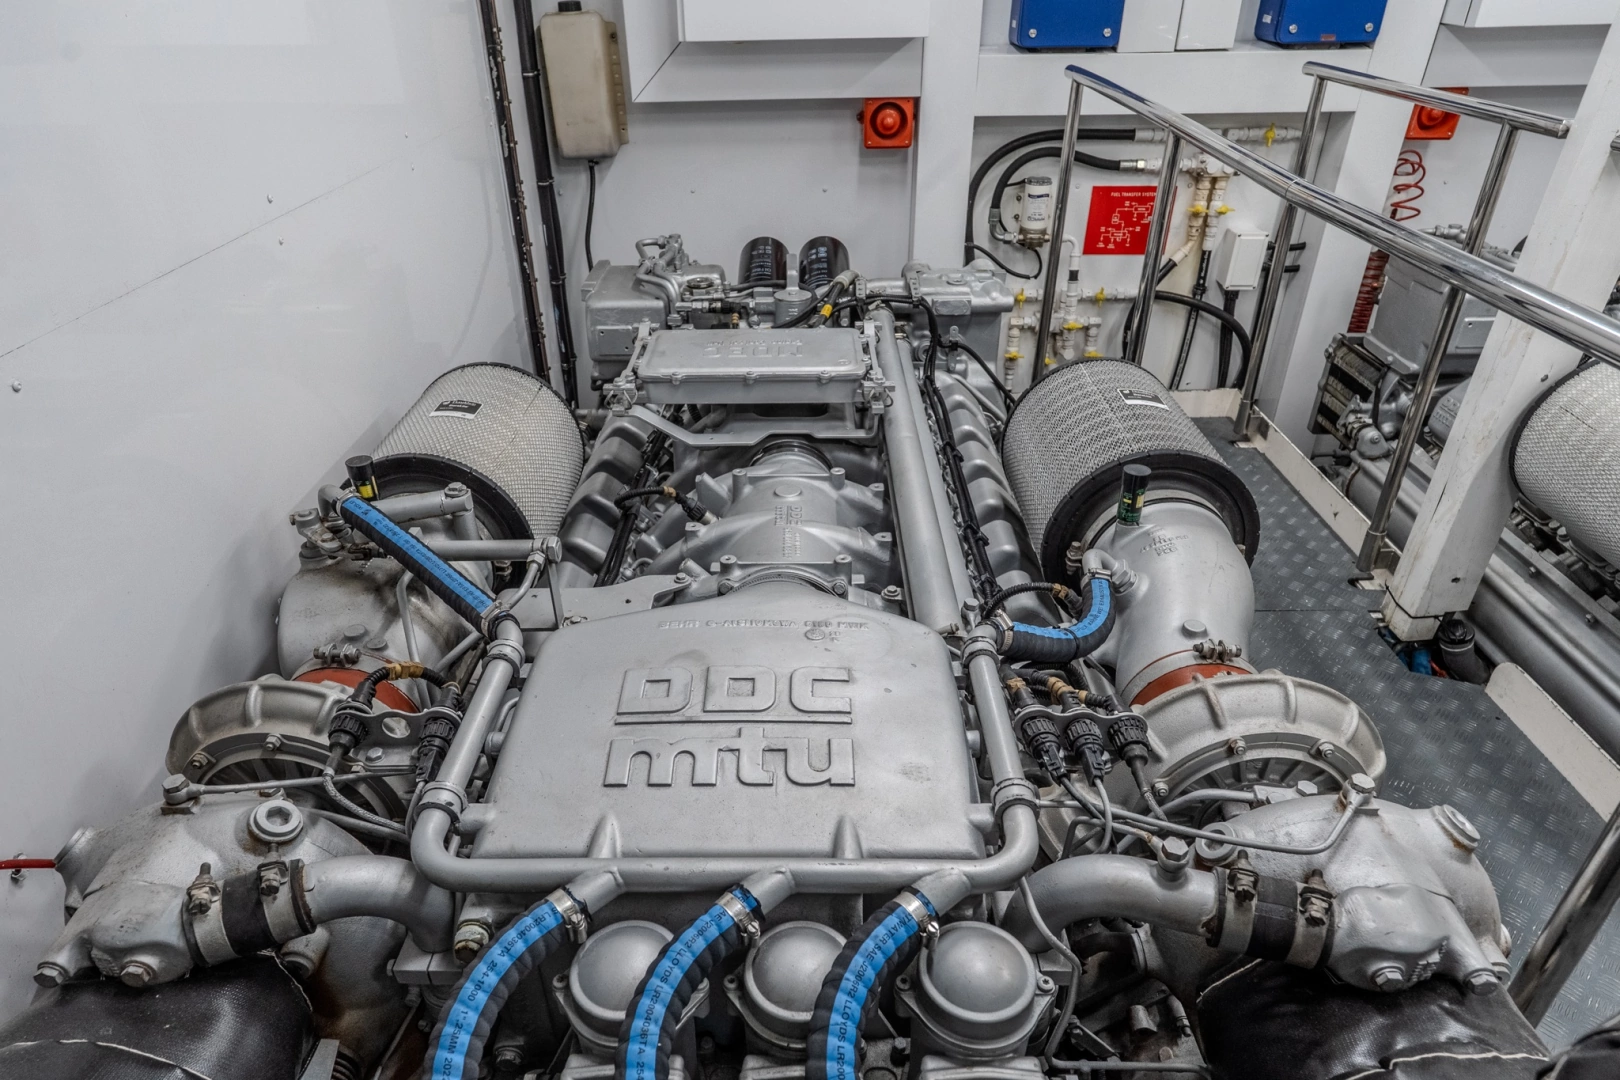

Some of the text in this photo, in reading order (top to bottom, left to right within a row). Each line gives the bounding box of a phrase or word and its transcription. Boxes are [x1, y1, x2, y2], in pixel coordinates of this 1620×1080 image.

[702, 346, 803, 358] MDEC
[616, 666, 853, 715] DDC
[603, 727, 856, 788] mtu
[497, 912, 552, 958] LR2004036TA
[685, 920, 714, 949] J2006R2
[714, 910, 728, 922] AE
[660, 946, 688, 985] LLOYDS
[865, 943, 882, 962] SAE
[467, 960, 498, 1002] 254-1000
[847, 961, 870, 999] J2006R2
[637, 984, 664, 1055] LR2004036TA
[840, 1000, 853, 1043] LLOYDS
